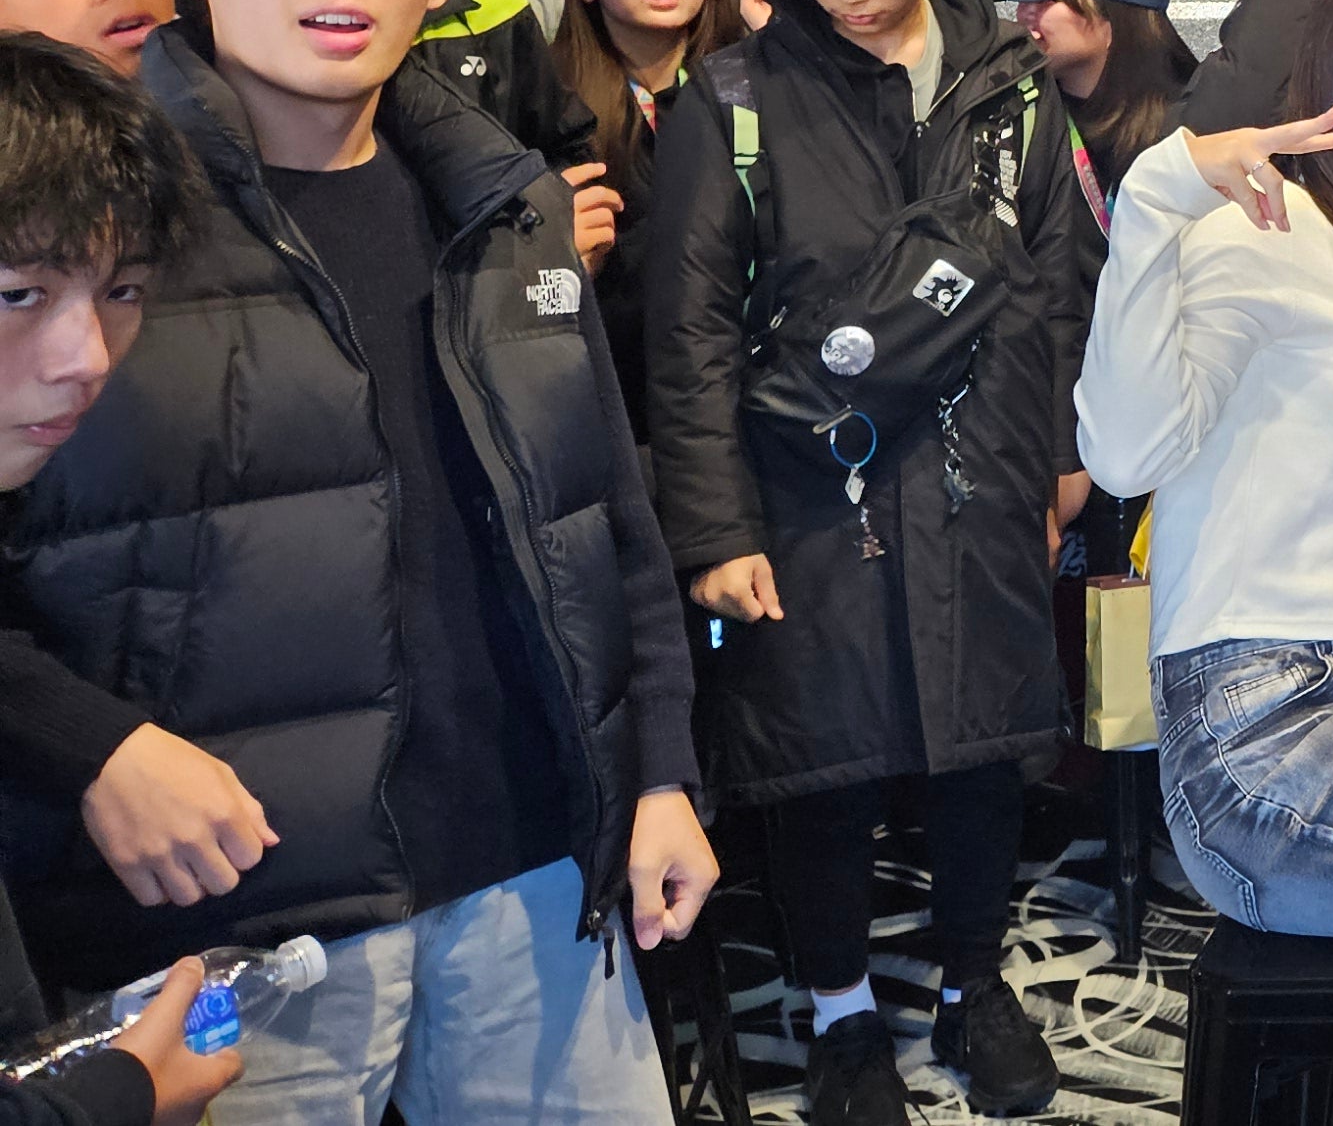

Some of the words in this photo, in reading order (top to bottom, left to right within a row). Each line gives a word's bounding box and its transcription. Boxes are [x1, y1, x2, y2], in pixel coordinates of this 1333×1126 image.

[538, 269, 562, 285] THE
[526, 284, 560, 302] NORTH
[537, 299, 562, 316] FACE
